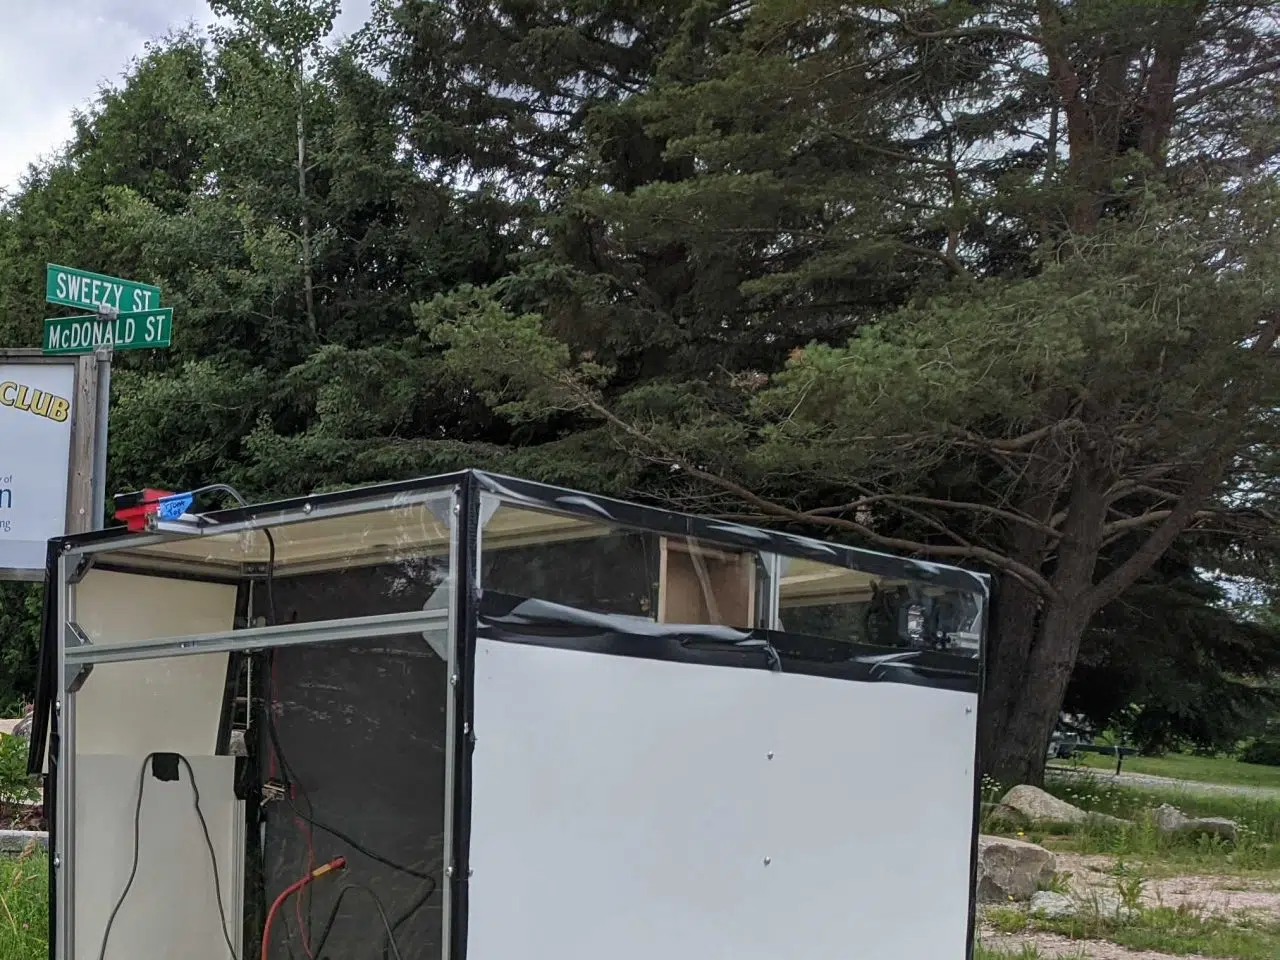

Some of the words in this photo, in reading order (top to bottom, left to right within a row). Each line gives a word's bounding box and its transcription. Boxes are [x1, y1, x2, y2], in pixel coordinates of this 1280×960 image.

[56, 272, 123, 313] SWEEZY
[132, 289, 151, 312] ST
[48, 318, 135, 349] McDONALD
[144, 315, 165, 341] ST
[3, 475, 13, 484] of
